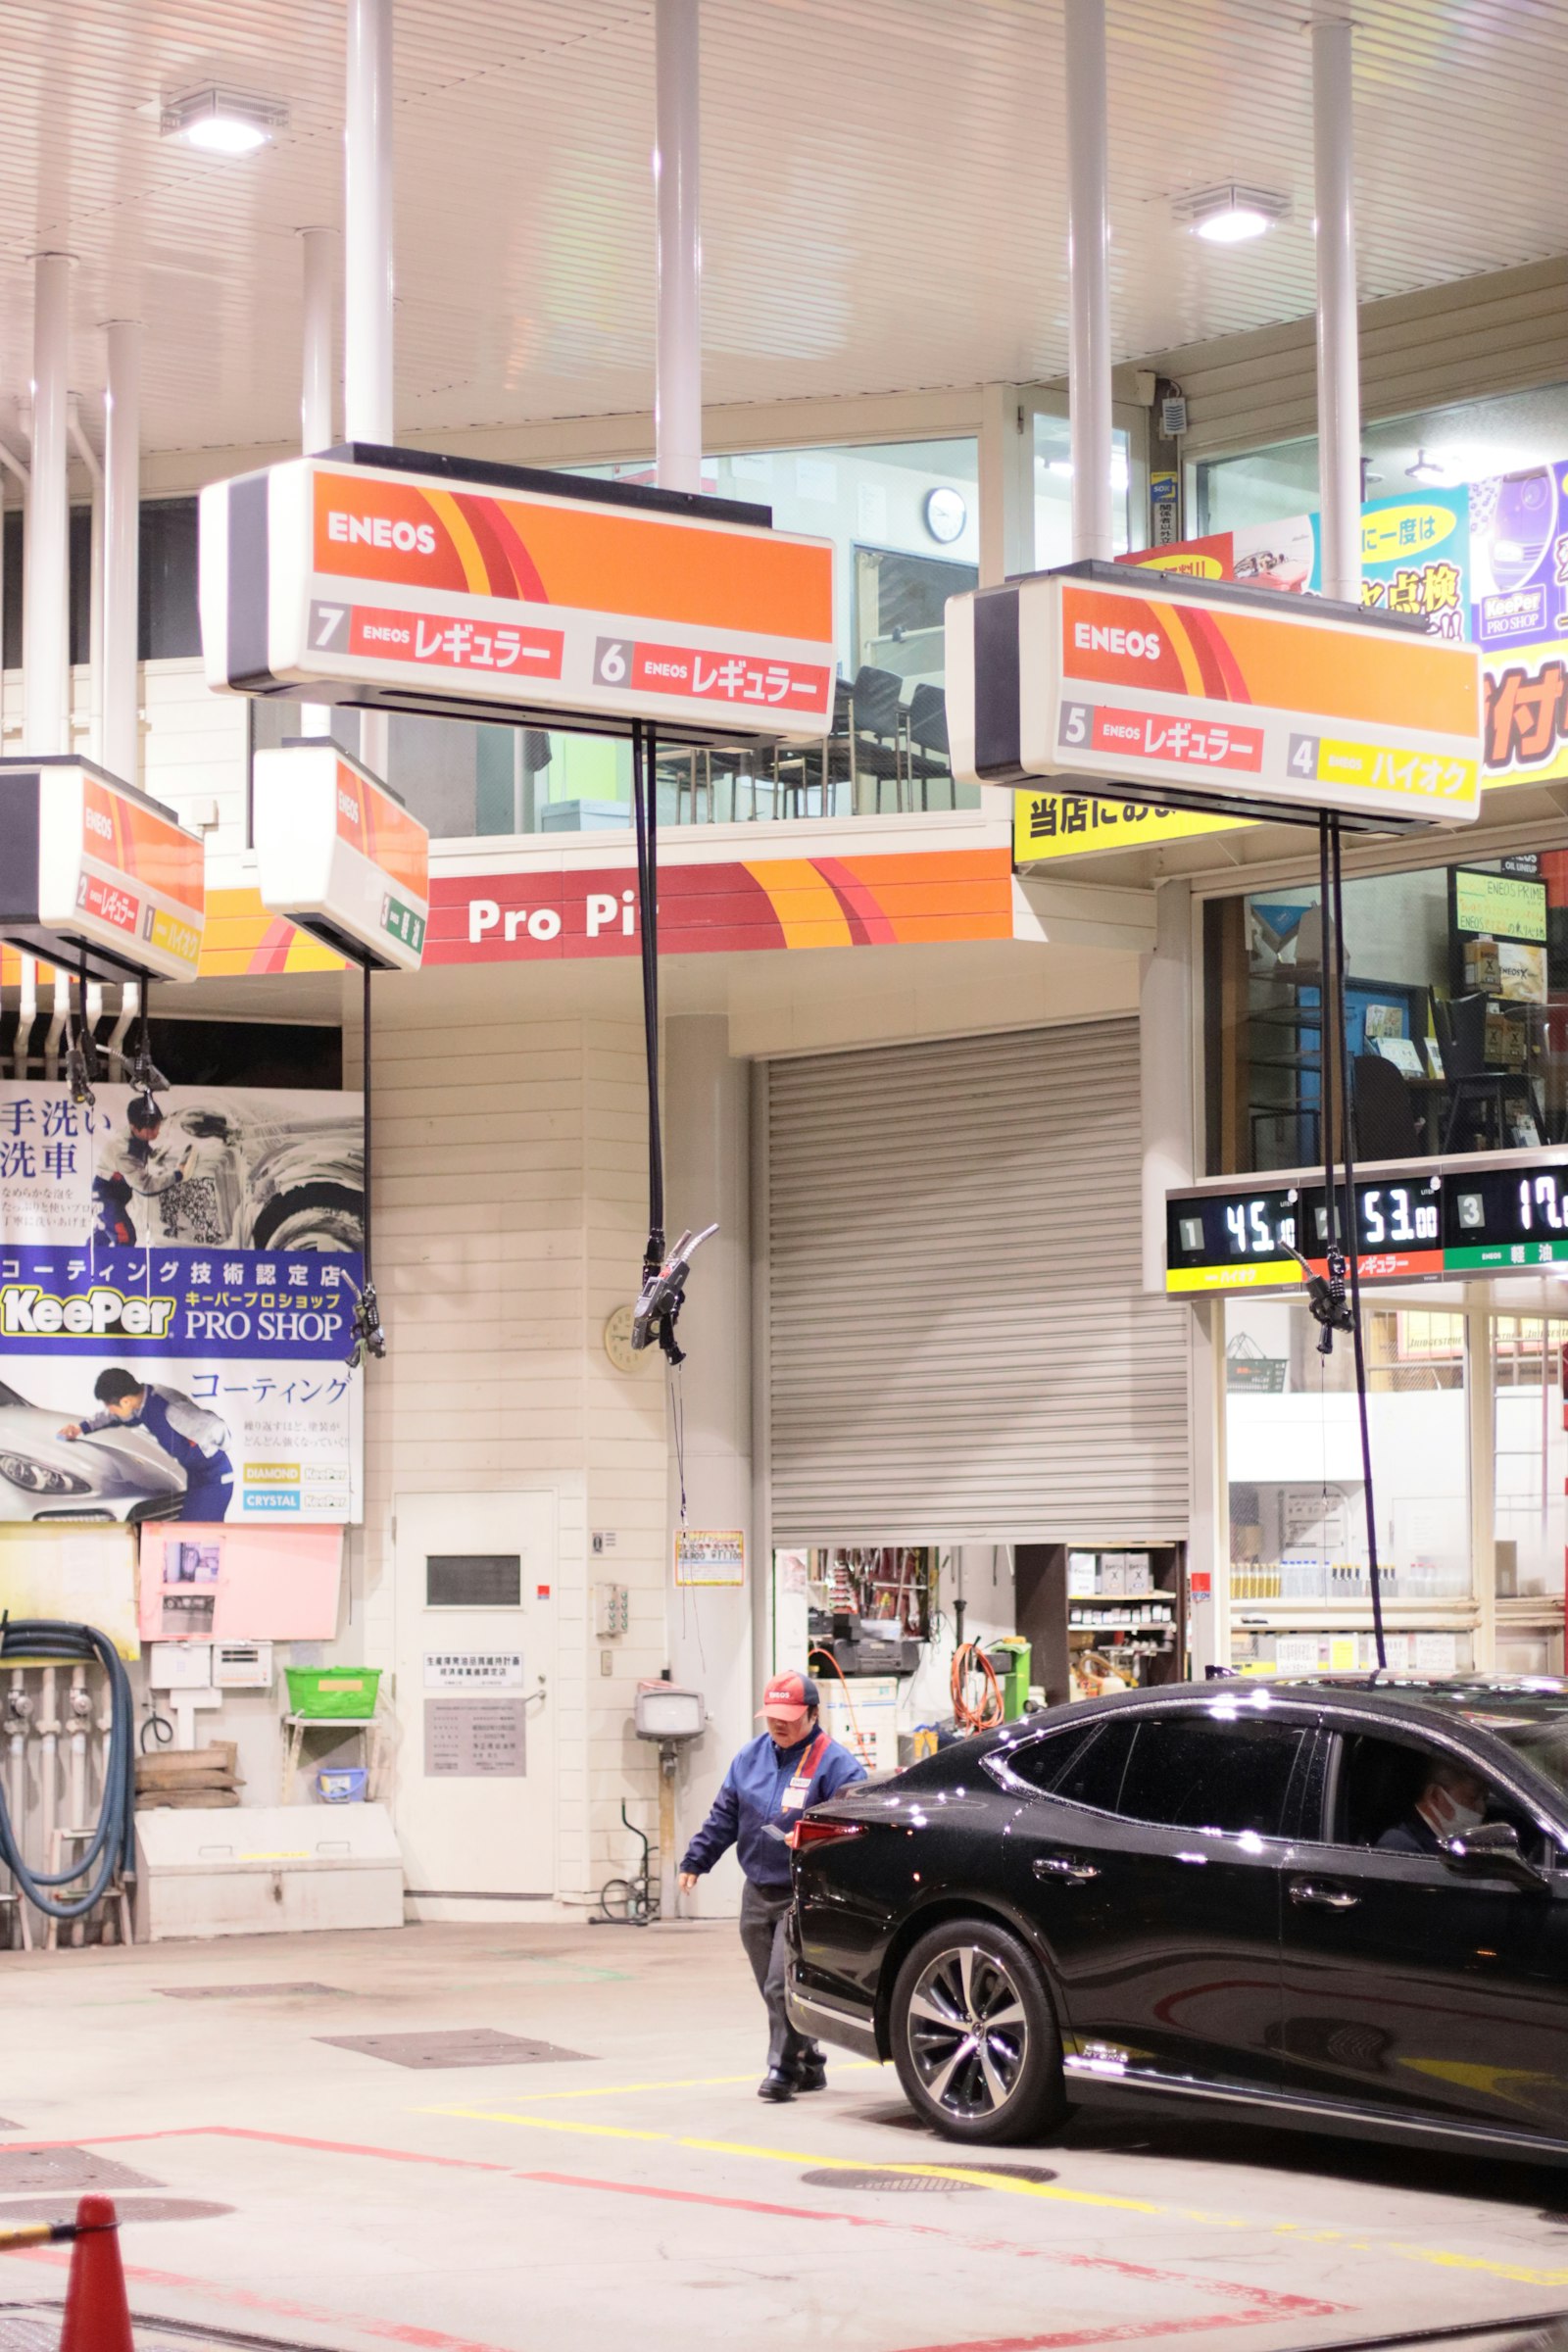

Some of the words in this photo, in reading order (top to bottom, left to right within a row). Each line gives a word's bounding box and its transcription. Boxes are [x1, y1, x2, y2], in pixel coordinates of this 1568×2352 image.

[328, 511, 436, 555] ENEOS
[1159, 504, 1172, 546] 関係者以外立
[1486, 594, 1541, 617] KeePer
[315, 607, 345, 647] 7
[1074, 621, 1160, 661] ENEOS
[1487, 617, 1509, 634] PRO
[1510, 613, 1539, 631] SHOP
[363, 624, 411, 644] ENEOS
[415, 618, 551, 668] レギュラー
[600, 644, 626, 683] 6
[644, 661, 688, 679] ENEOS
[692, 656, 817, 703] レギュラー
[1065, 707, 1087, 743] 5
[1102, 723, 1141, 741] ENEOS
[1144, 718, 1253, 762] レギュラー
[1292, 740, 1313, 774] 4
[1328, 755, 1363, 771] ENEOS
[1371, 752, 1467, 795] ハイオク
[85, 807, 113, 841] ENEOS
[338, 789, 360, 824] ENEOS
[78, 875, 88, 906] 2
[101, 887, 135, 925] レギュラー
[1487, 881, 1518, 898] ENEOS
[1518, 884, 1546, 901] PRIME
[146, 909, 154, 938] 1
[468, 899, 562, 944] Pro
[586, 889, 660, 938] Pi
[167, 923, 199, 958] ハイオク
[0, 1099, 112, 1137] 手洗い
[0, 1141, 77, 1180] 洗車
[1463, 1197, 1481, 1225] 3
[1185, 1221, 1197, 1248] 1
[1482, 1251, 1502, 1261] ENEOS
[1510, 1243, 1553, 1264] 軽油
[2, 1260, 341, 1288] コーティング技術認定店
[1220, 1268, 1256, 1284] ハイオク
[1, 1287, 174, 1337] KeePer
[184, 1310, 251, 1341] PRO
[257, 1311, 343, 1342] SHOP
[191, 1374, 352, 1405] コーティング
[246, 1467, 298, 1480] DIAMOND
[246, 1494, 297, 1507] CRYSTAL
